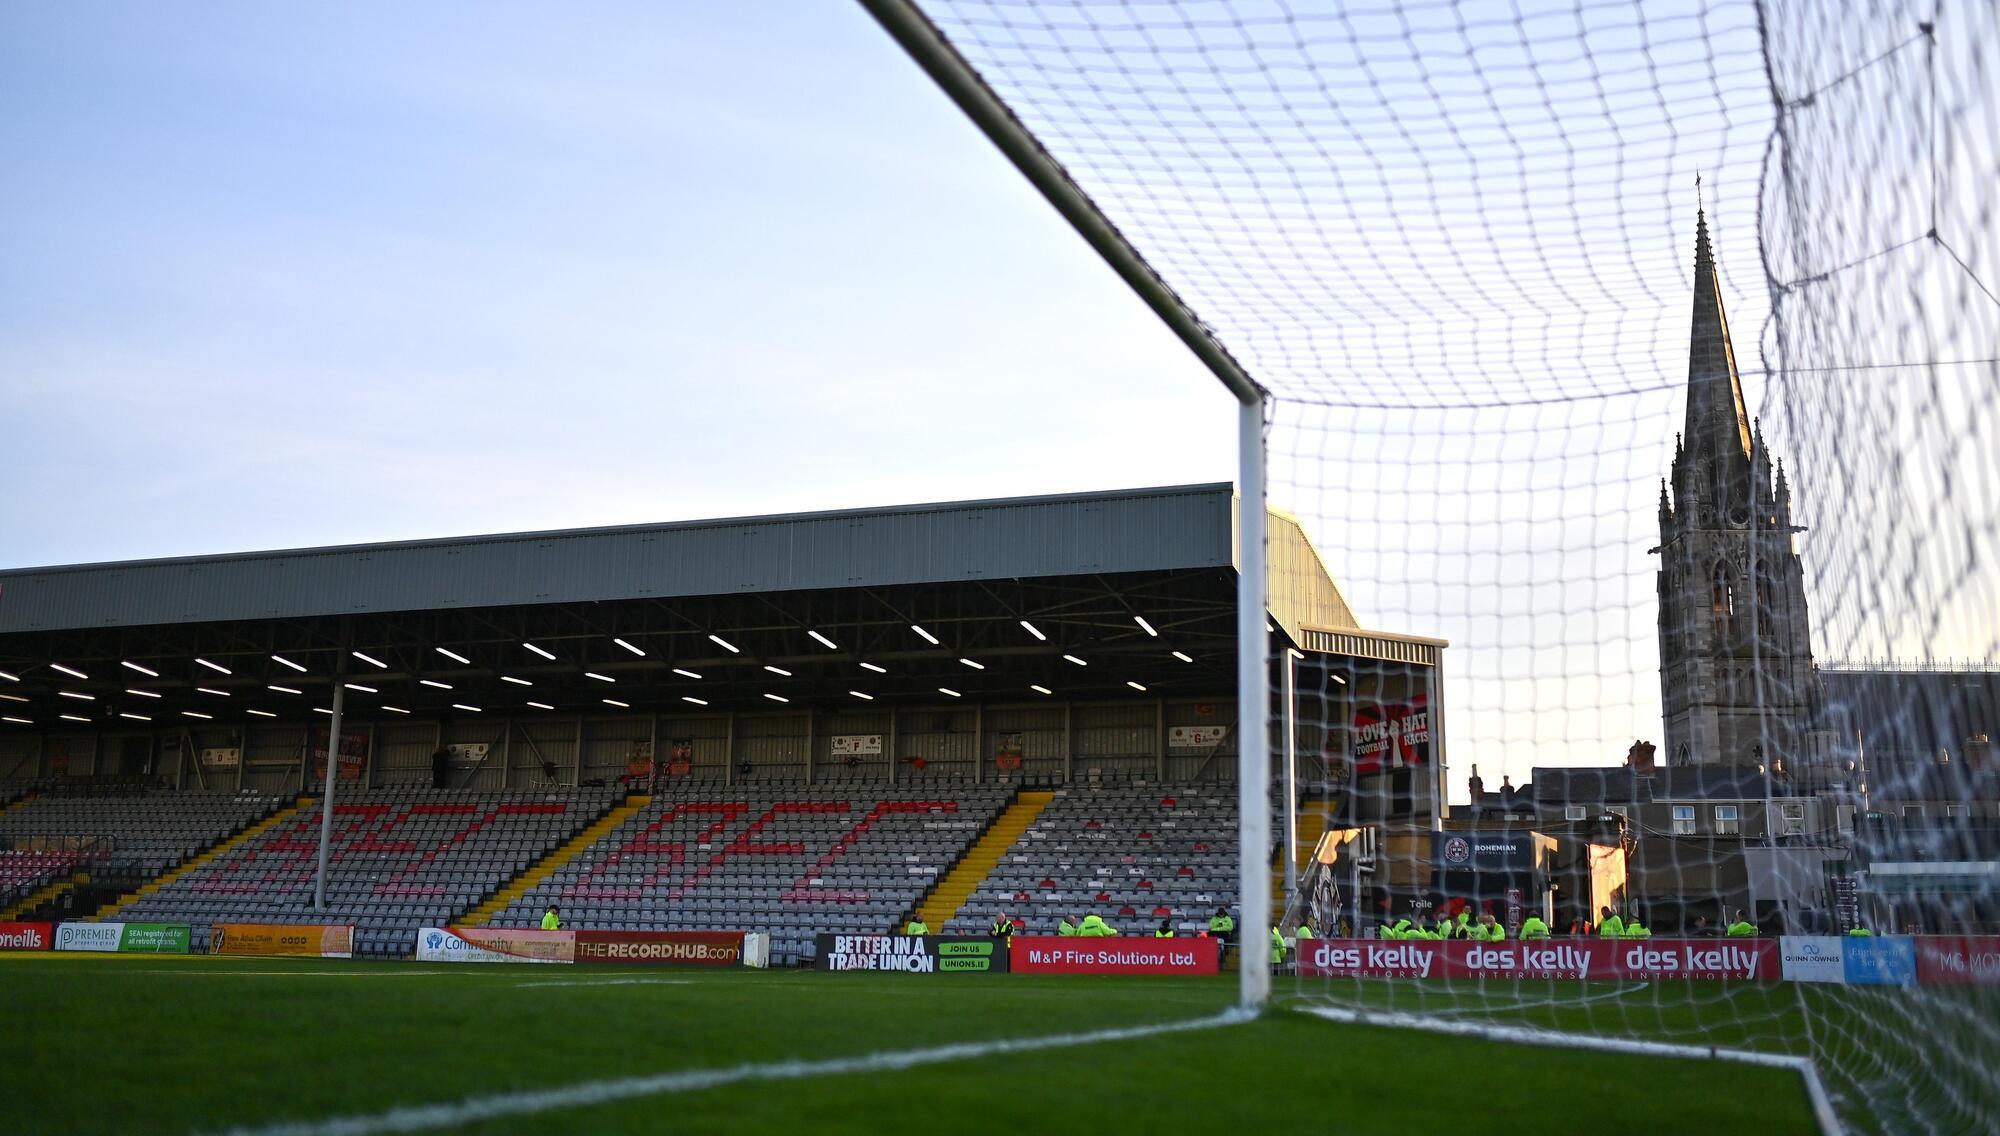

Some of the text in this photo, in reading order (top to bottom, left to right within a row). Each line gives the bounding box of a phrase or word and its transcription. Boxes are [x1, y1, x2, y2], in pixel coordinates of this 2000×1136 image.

[1355, 712, 1428, 744] LOVE HAT
[854, 742, 859, 751] F
[1357, 731, 1430, 755] FOOTBALL RACIS
[1474, 844, 1517, 852] BOHEMIAN
[75, 928, 116, 940] PREMIER
[445, 936, 513, 951] Community
[834, 935, 926, 955] BETTER IN A
[950, 945, 981, 953] JOIN US
[827, 953, 934, 972] TRADE UNION
[945, 960, 985, 968] UNIONS.IE
[1066, 951, 1095, 964] Fire
[1098, 951, 1165, 965] Solutions
[1170, 952, 1197, 966] Ltd.
[1315, 945, 1433, 978] des kelly
[1466, 945, 1591, 979] des kelly
[1626, 946, 1759, 979] des kelly
[1940, 952, 1964, 972] MG
[1317, 970, 1418, 978] INTERIORS
[1469, 971, 1577, 979] INTERIORS
[1629, 972, 1743, 980] INTERIORS
